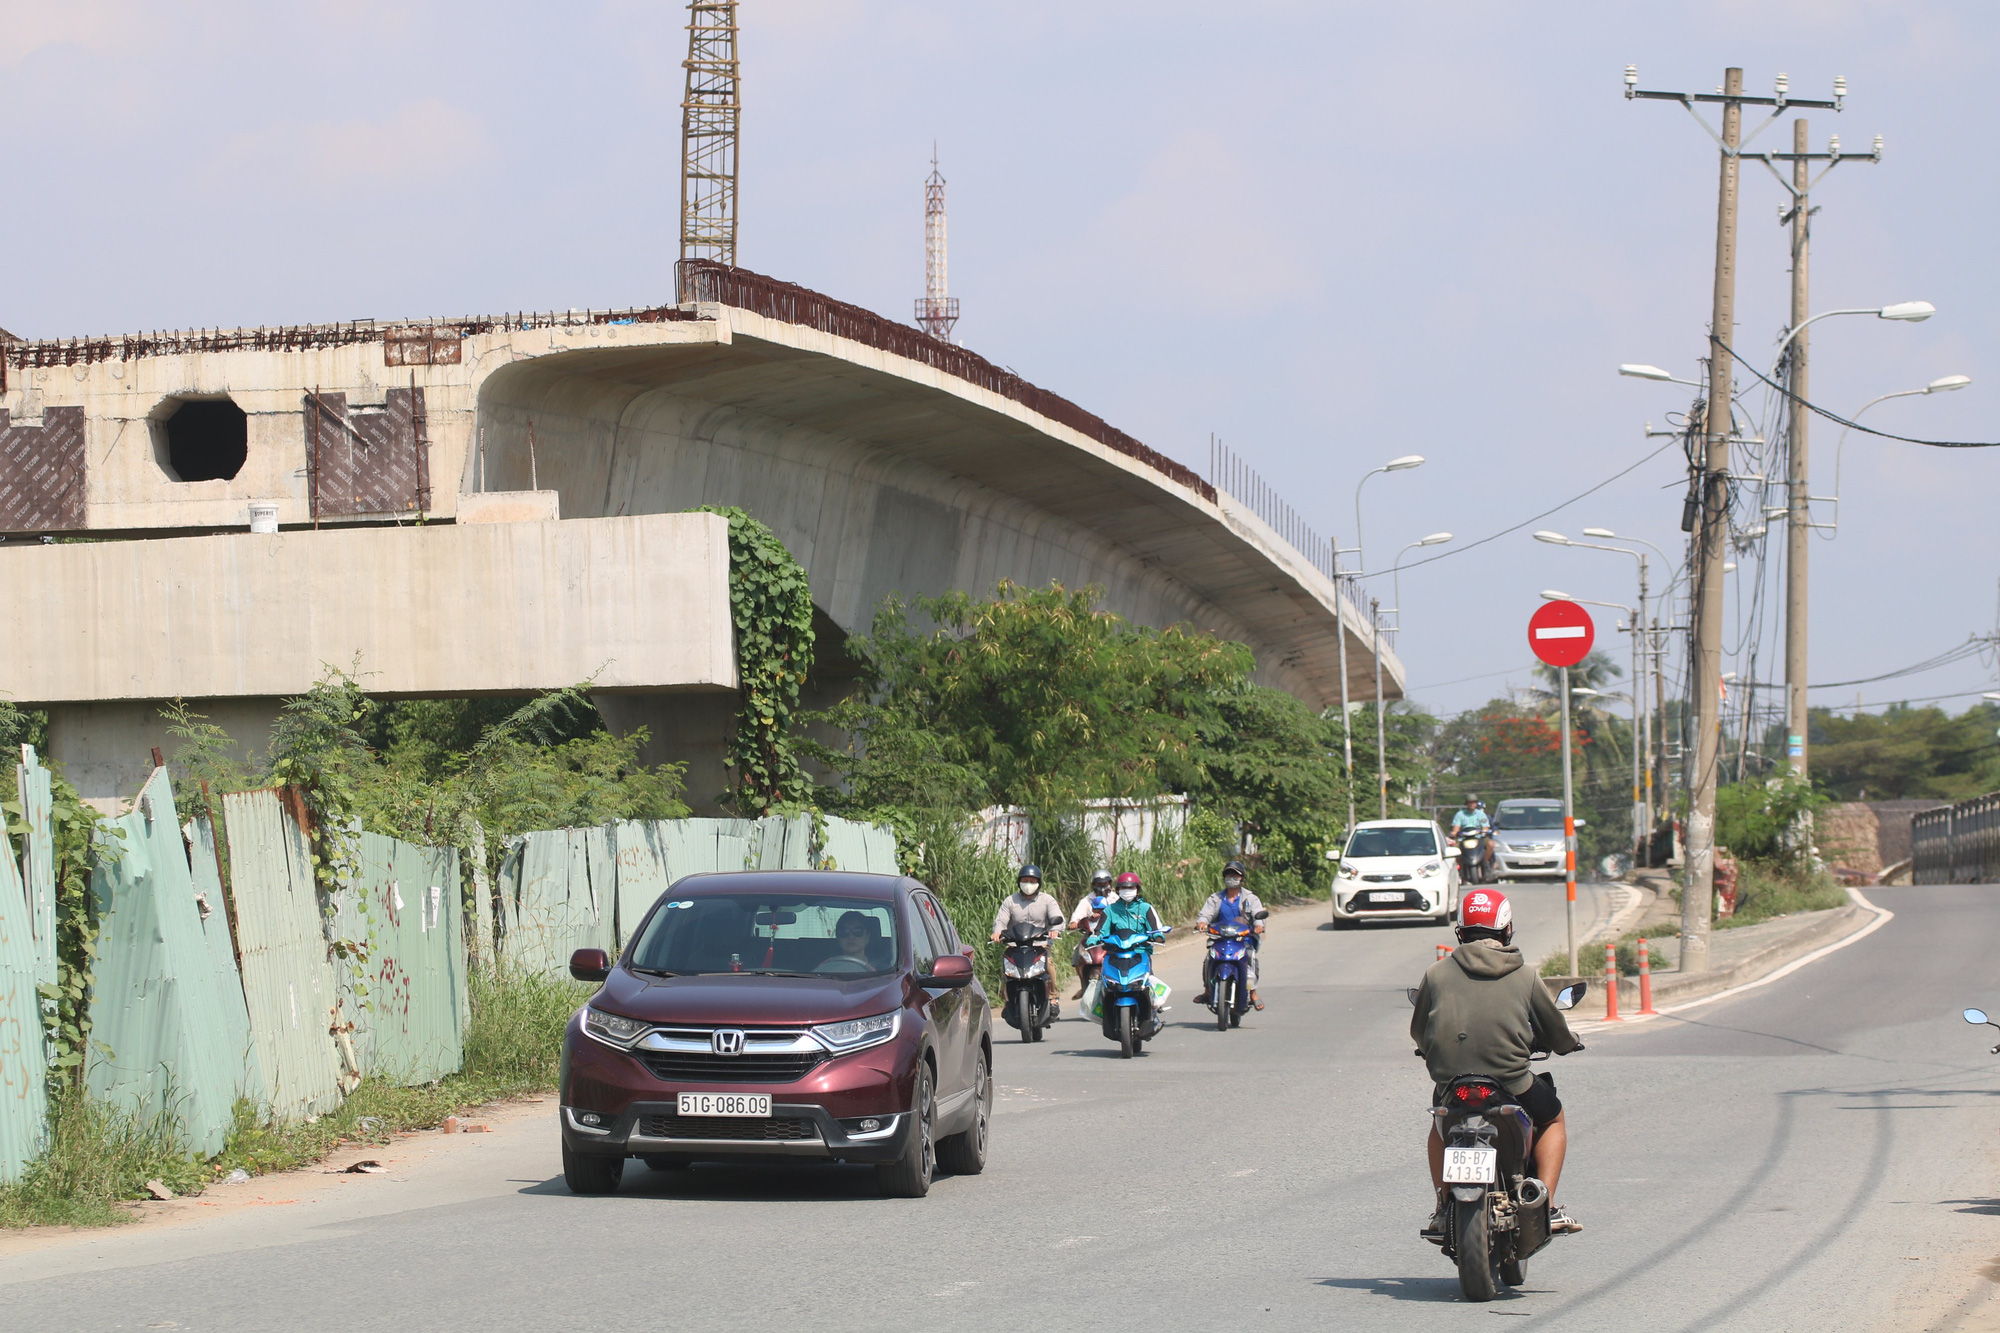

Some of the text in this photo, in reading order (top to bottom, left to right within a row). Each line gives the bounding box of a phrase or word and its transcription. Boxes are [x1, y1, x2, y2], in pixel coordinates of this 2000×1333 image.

[681, 1096, 768, 1114] 51G-086.09
[1452, 1151, 1488, 1165] 86-B7
[1446, 1165, 1491, 1182] 413.51
